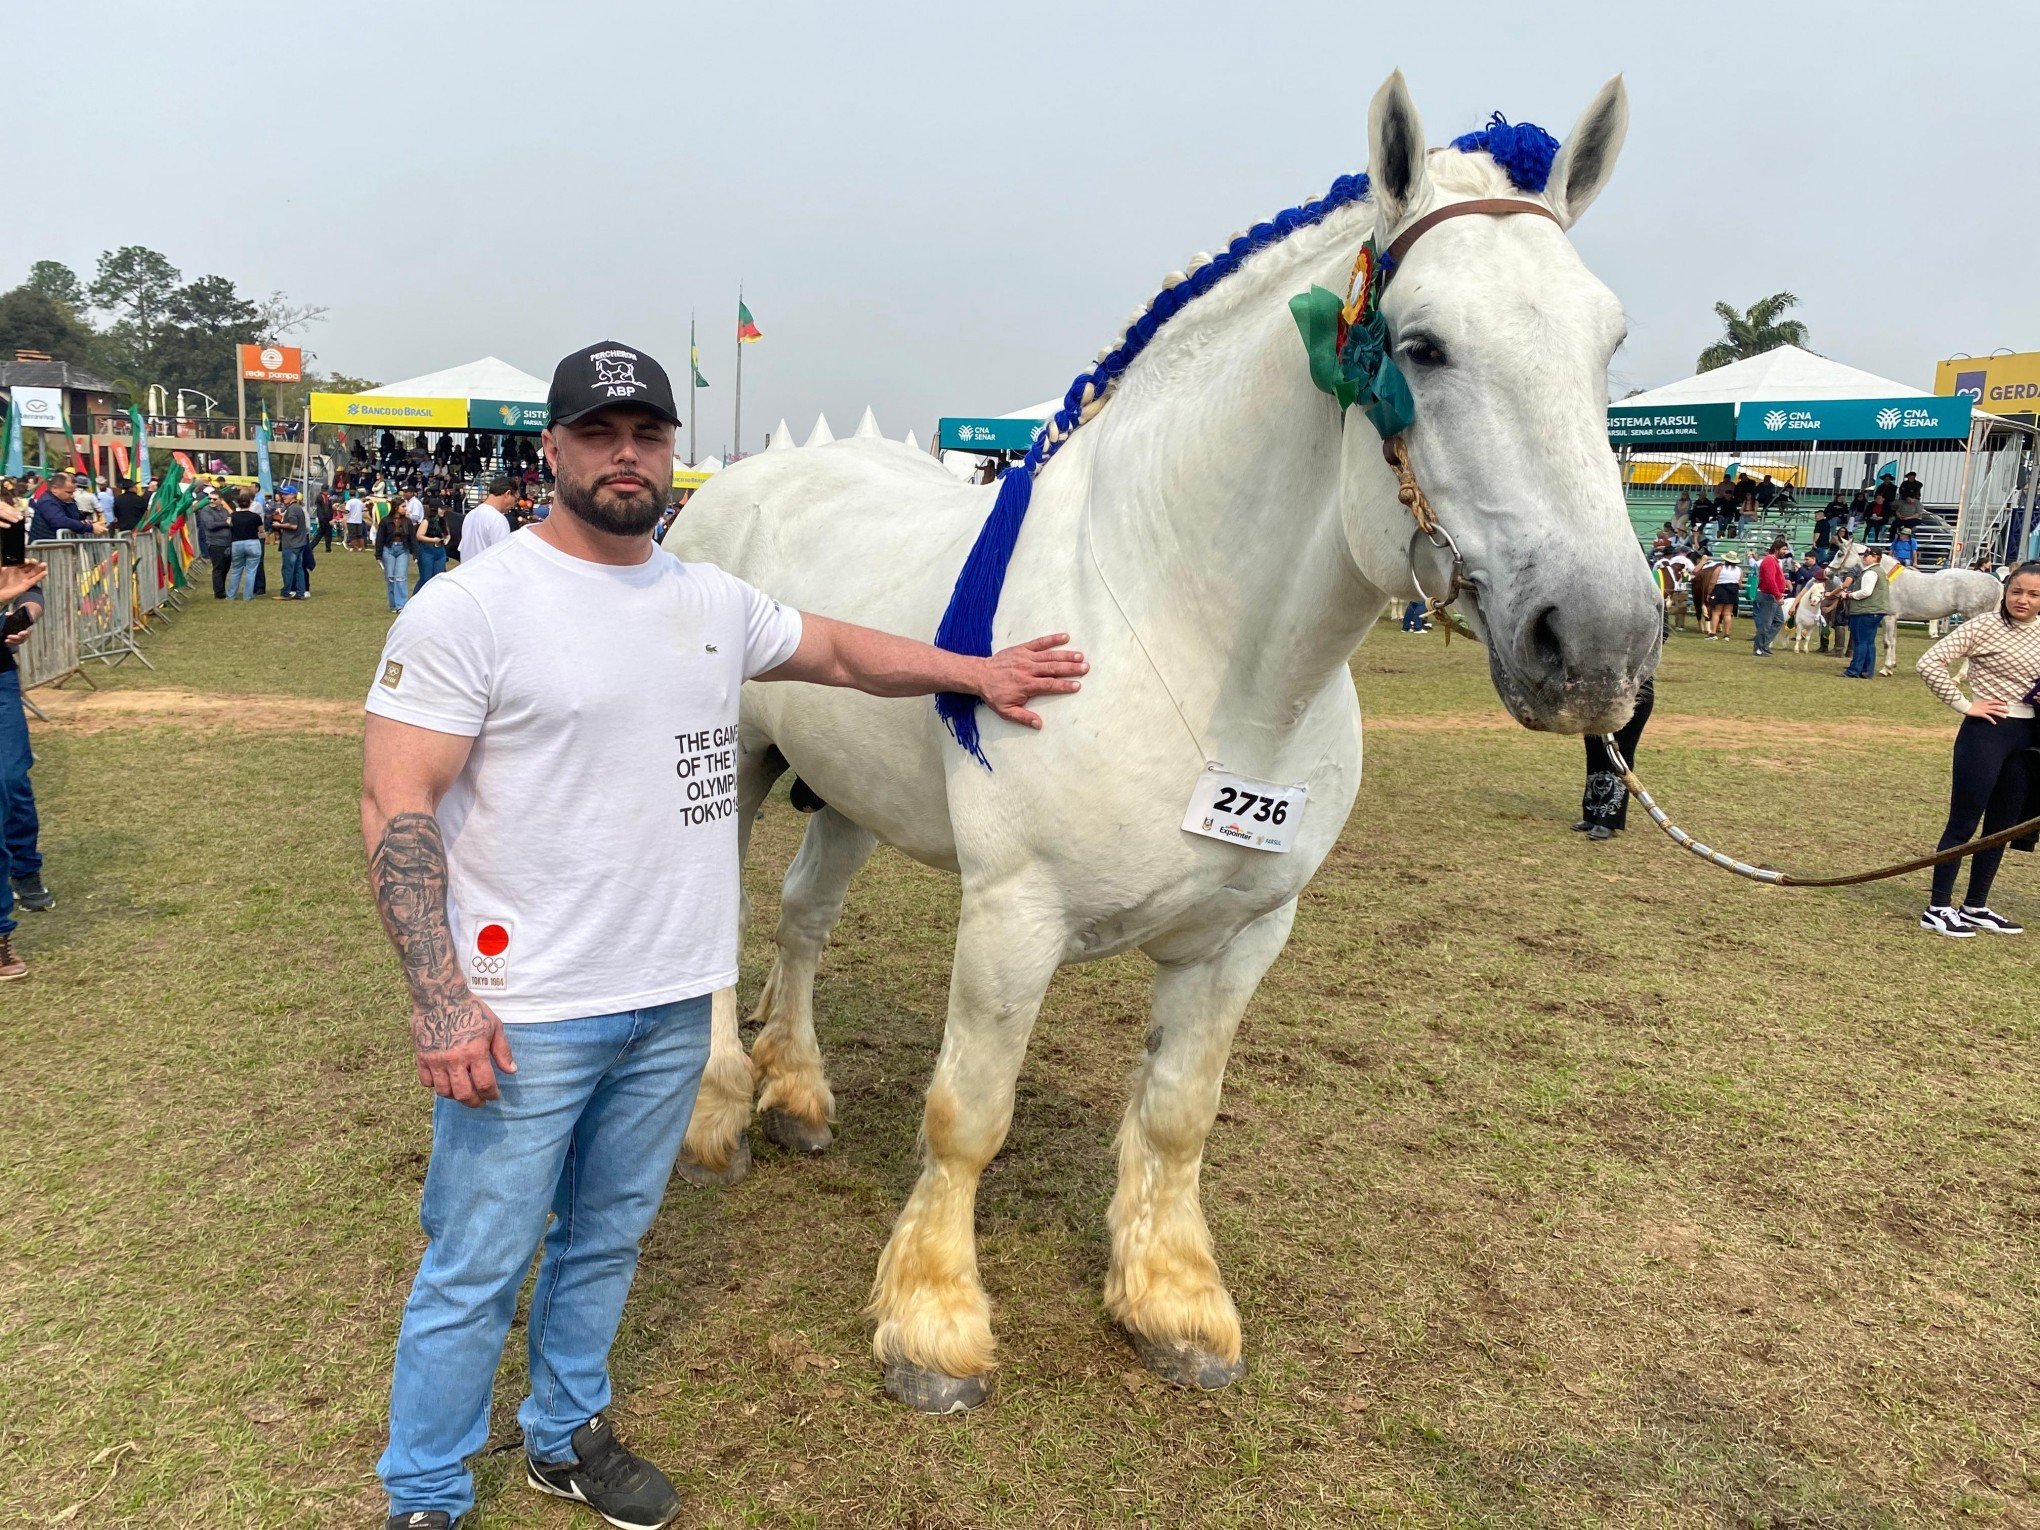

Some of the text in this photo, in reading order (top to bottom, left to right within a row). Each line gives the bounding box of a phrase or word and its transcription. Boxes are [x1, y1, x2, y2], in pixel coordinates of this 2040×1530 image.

[590, 350, 638, 362] PERCHERON
[245, 370, 299, 380] rede pampa
[606, 386, 636, 397] ABP
[361, 405, 433, 417] BANCO DO BRASIL
[1789, 412, 1812, 420] CNA
[1903, 409, 1928, 418] CNA
[1606, 415, 1698, 427] SISTEMA FARSUL
[1787, 420, 1821, 429] SENAR
[1902, 418, 1939, 428] SENAR
[1607, 429, 1628, 437] ARSUL
[1655, 428, 1674, 436] CASA
[675, 731, 710, 754] THE
[676, 756, 701, 779] OF
[704, 750, 731, 773] THE
[1213, 787, 1289, 825] 2736
[1219, 826, 1251, 840] Expointer
[471, 976, 489, 986] TOKYO
